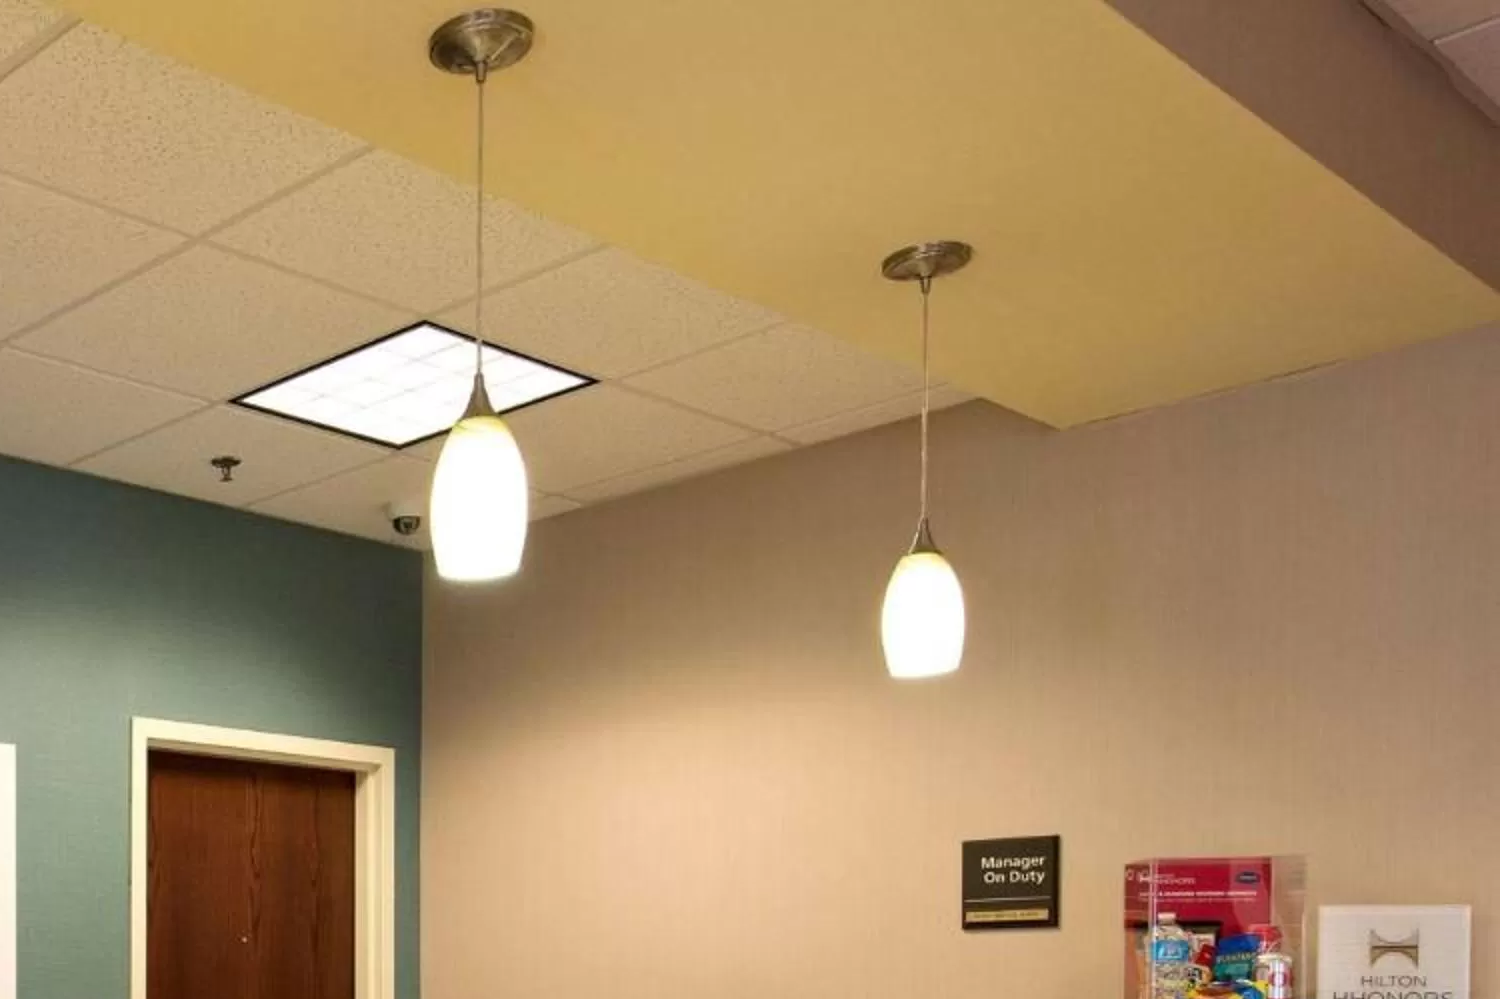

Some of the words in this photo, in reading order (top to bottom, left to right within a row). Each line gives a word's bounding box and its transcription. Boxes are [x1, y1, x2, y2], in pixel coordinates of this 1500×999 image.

[981, 856, 1046, 870] Manager
[984, 871, 1005, 884] On
[1009, 870, 1045, 885] Duty
[1361, 975, 1427, 988] HILTON
